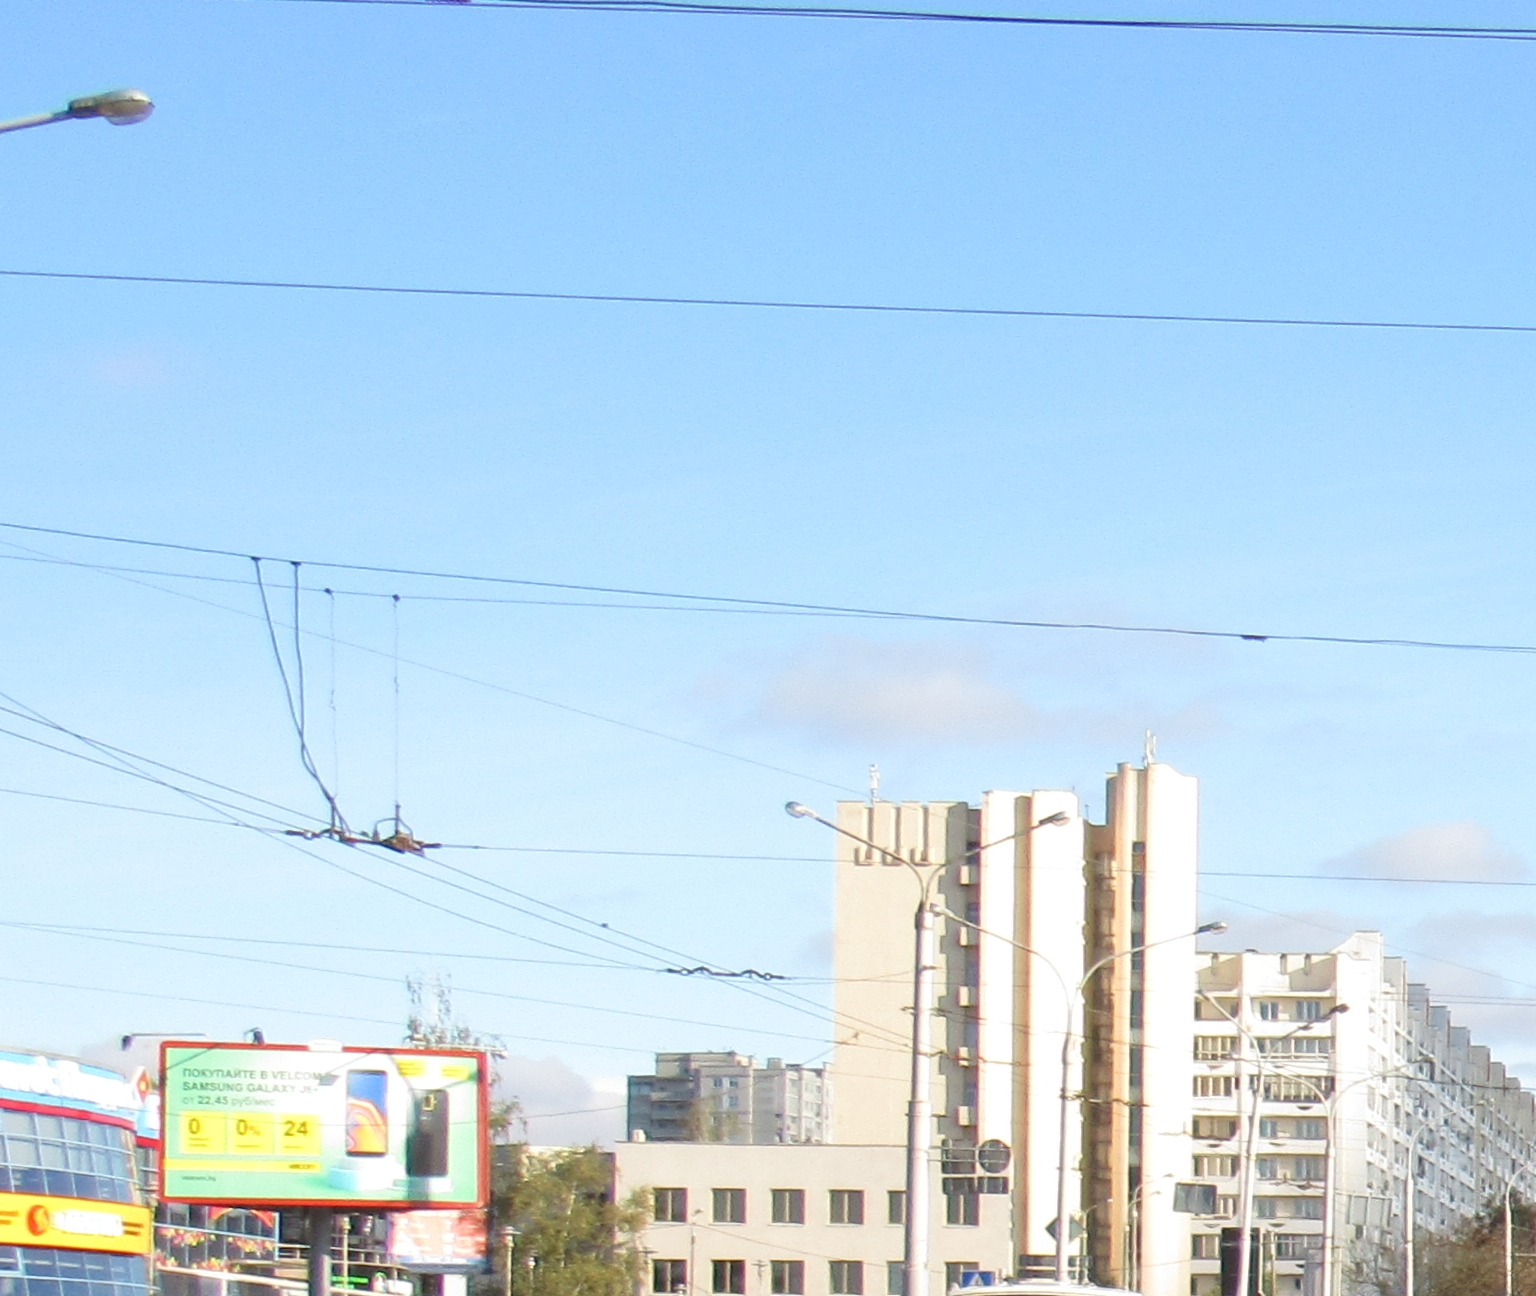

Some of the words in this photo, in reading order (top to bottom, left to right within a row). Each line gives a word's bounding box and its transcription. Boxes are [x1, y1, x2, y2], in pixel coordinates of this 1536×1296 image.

[182, 1067, 256, 1080] ПОКУПАЙТЕ
[182, 1081, 243, 1093] SAMSUNG
[247, 1083, 296, 1093] GALAXY
[283, 1120, 309, 1137] 24
